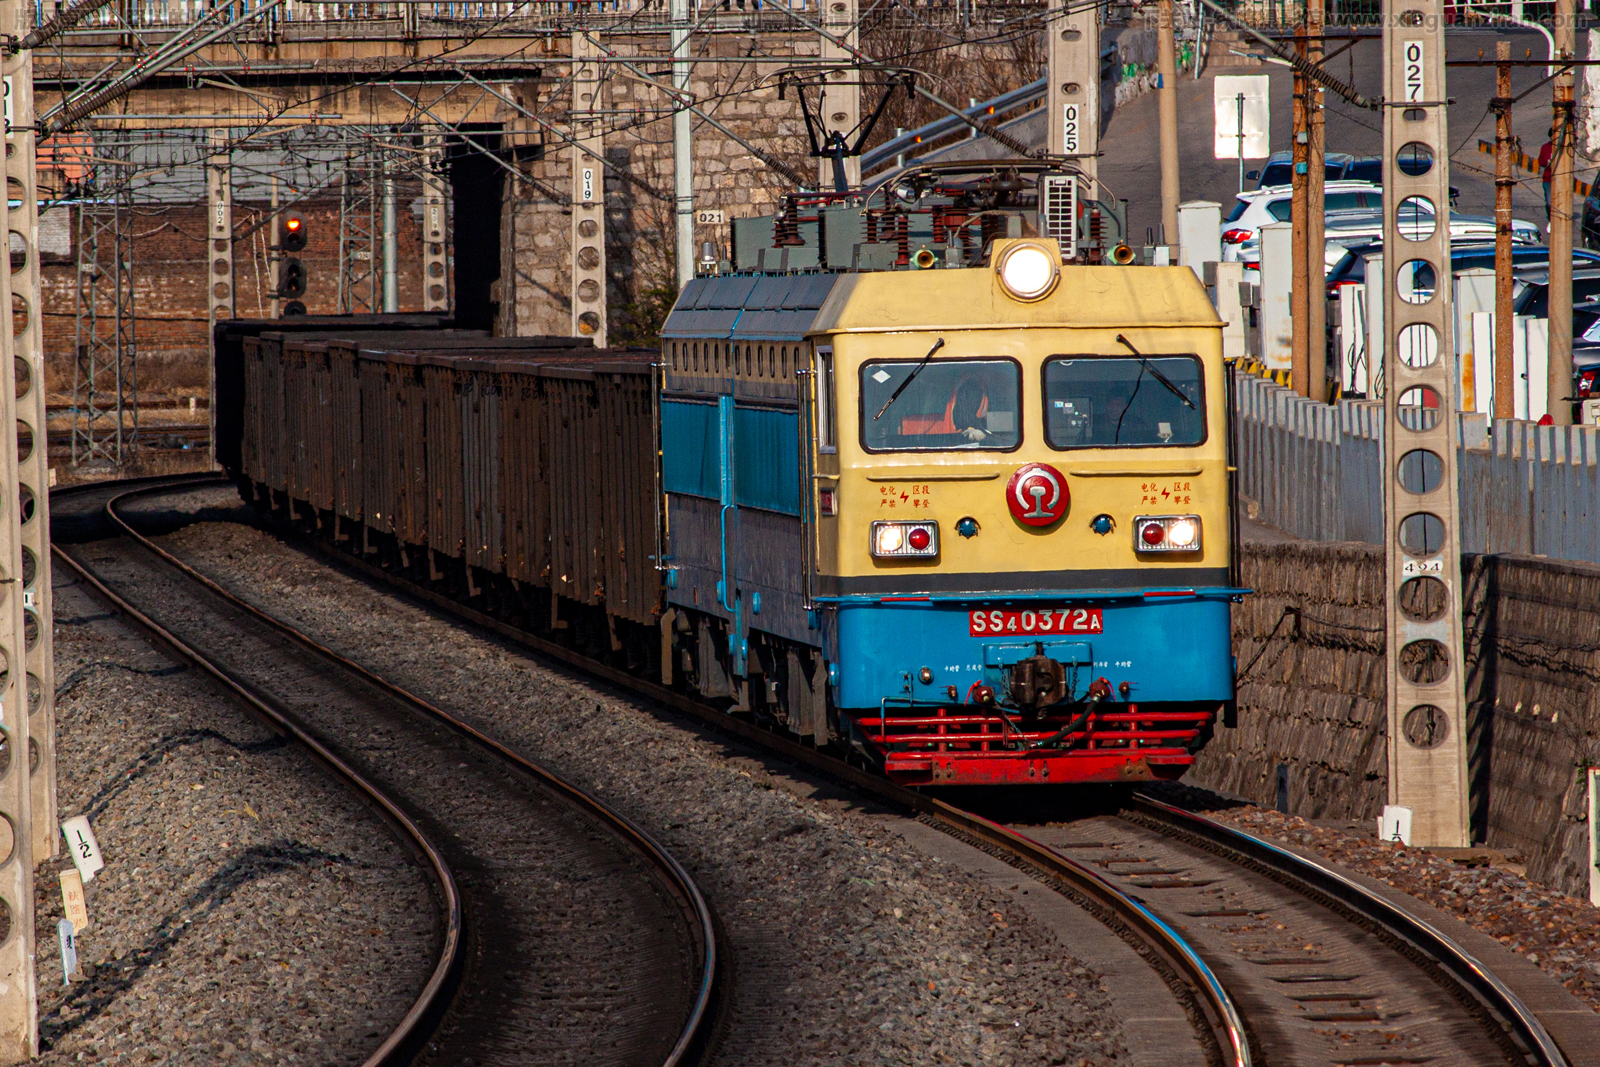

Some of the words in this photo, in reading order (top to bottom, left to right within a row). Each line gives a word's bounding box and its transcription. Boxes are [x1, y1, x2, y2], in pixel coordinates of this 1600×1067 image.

[1407, 44, 1421, 101] 027
[1066, 107, 1077, 151] 025
[584, 170, 592, 199] 019
[698, 213, 721, 223] 021
[880, 486, 896, 495] 电化
[912, 485, 930, 495] 区段
[1141, 483, 1158, 493] 电化
[1174, 482, 1191, 492] 区段
[880, 498, 896, 508] 严禁
[1141, 495, 1158, 505] 严禁
